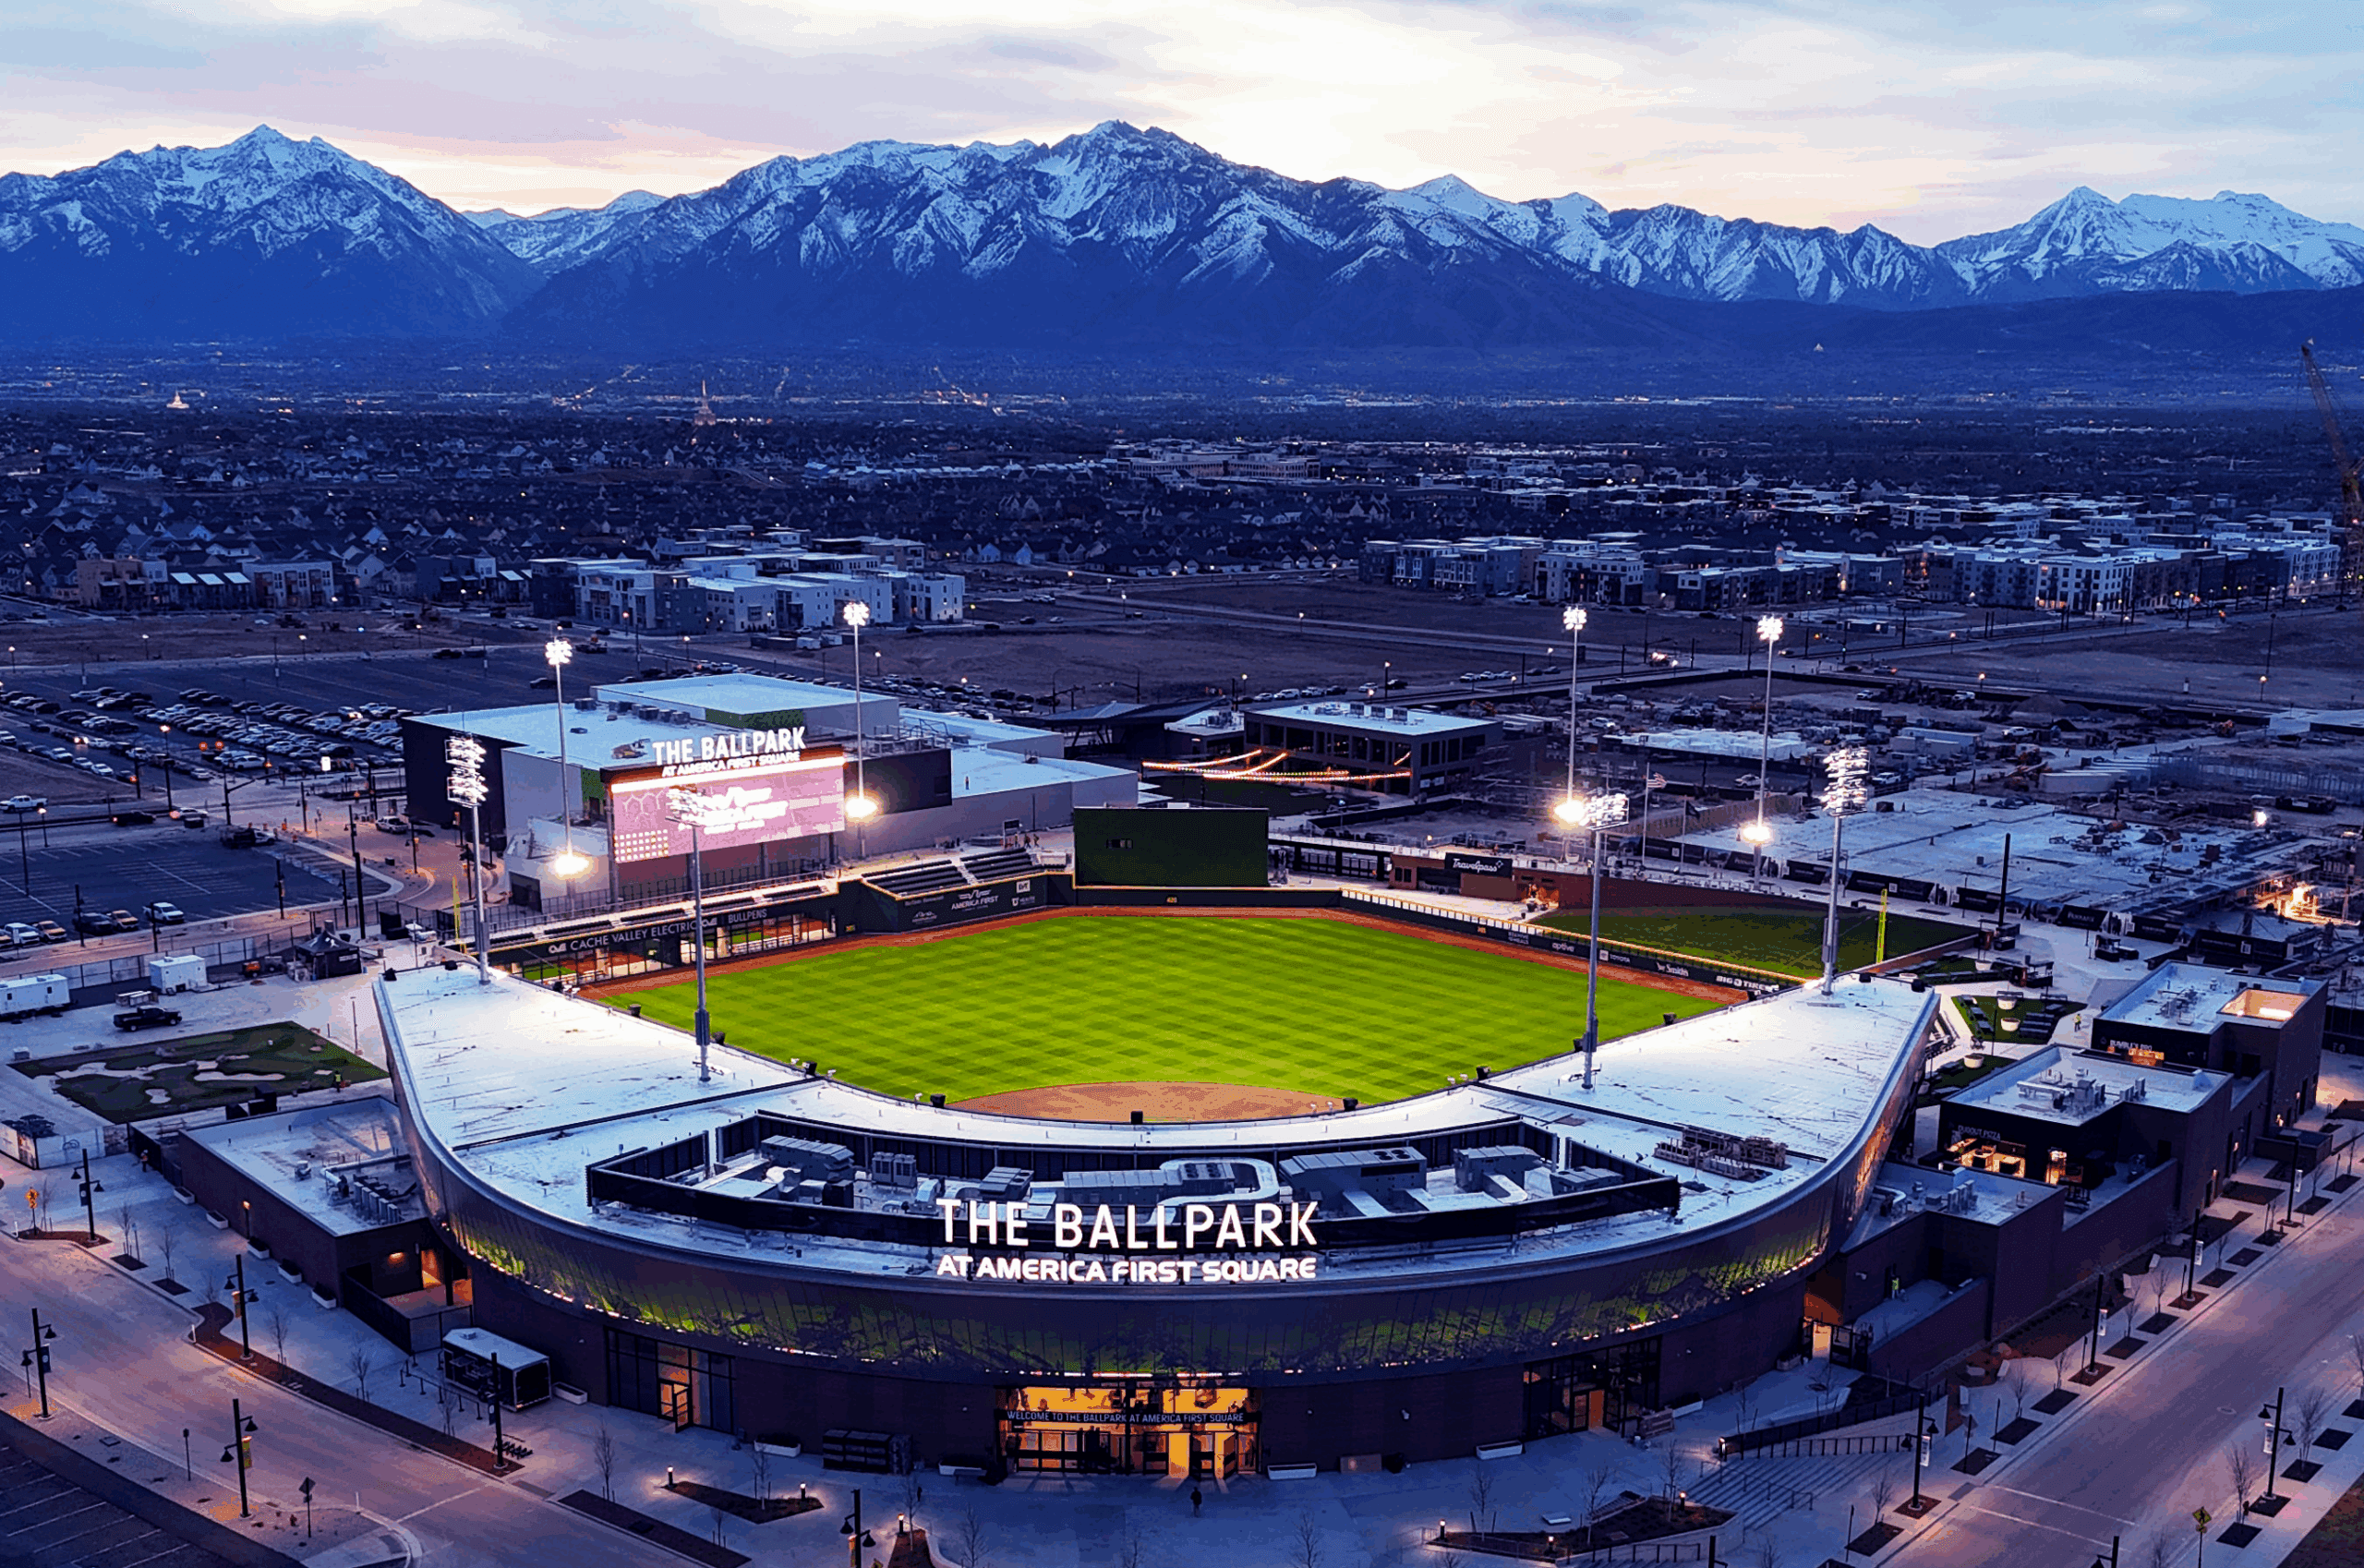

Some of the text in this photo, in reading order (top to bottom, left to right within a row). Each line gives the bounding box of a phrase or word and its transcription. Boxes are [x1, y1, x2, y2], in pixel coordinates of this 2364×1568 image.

[652, 726, 806, 766] THE BALLPARK
[661, 751, 801, 777] AT AMERICA FIRST SQUARE
[727, 909, 767, 924] BULLPENS
[570, 935, 609, 951] CACHE
[610, 928, 648, 943] VALLEY
[651, 920, 697, 937] ELECTRIC
[1716, 975, 1732, 984] BIG
[935, 1198, 1318, 1248] THE BALLPARK
[936, 1254, 1317, 1283] AT AMERICA FIRST SQUARE
[1007, 1411, 1244, 1422] WELCOME TO THE BALLPARK AT AMERICA FIRST SQUARE
